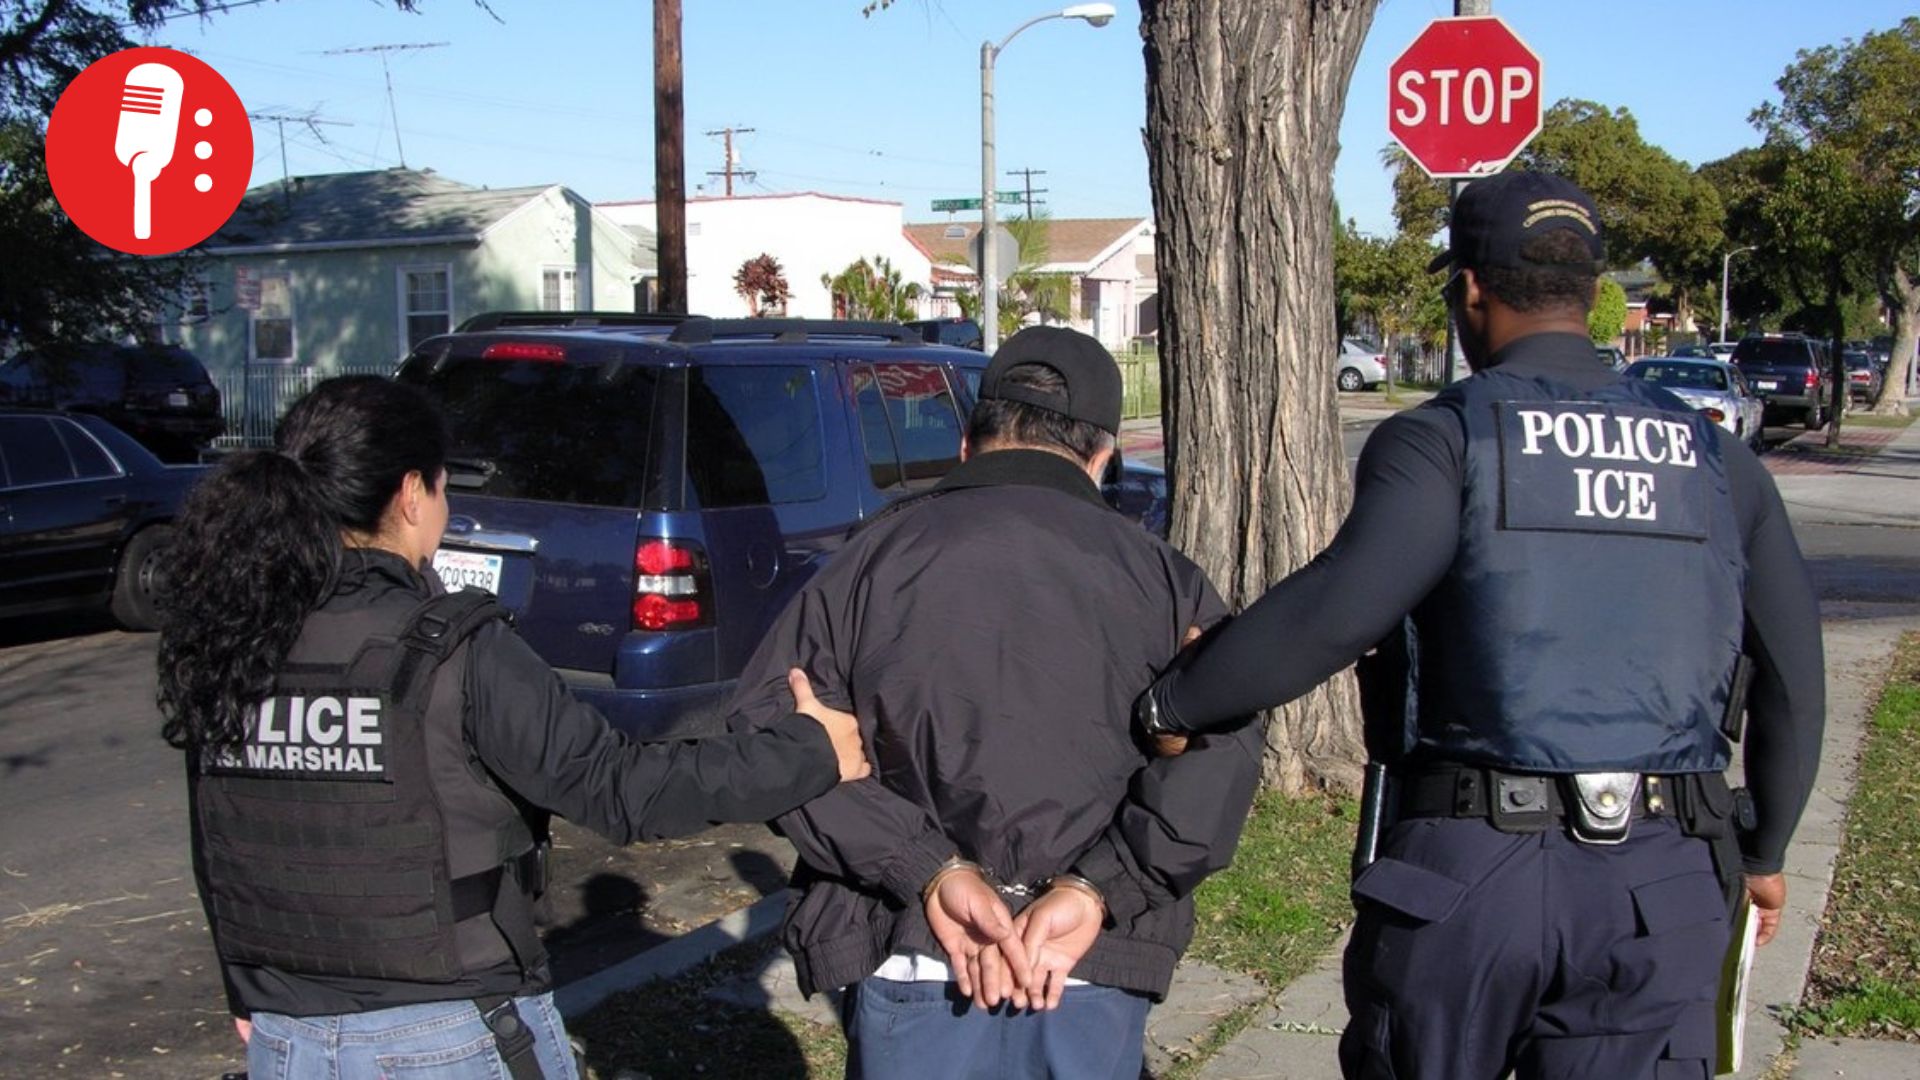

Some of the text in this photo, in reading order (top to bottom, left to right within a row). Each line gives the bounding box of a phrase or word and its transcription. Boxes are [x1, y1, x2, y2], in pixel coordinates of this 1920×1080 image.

[1396, 66, 1533, 127] STOP
[1517, 410, 1697, 467] POLICE
[1573, 468, 1656, 521] ICE
[246, 696, 382, 744] LICE
[246, 745, 383, 772] MARSHAL
